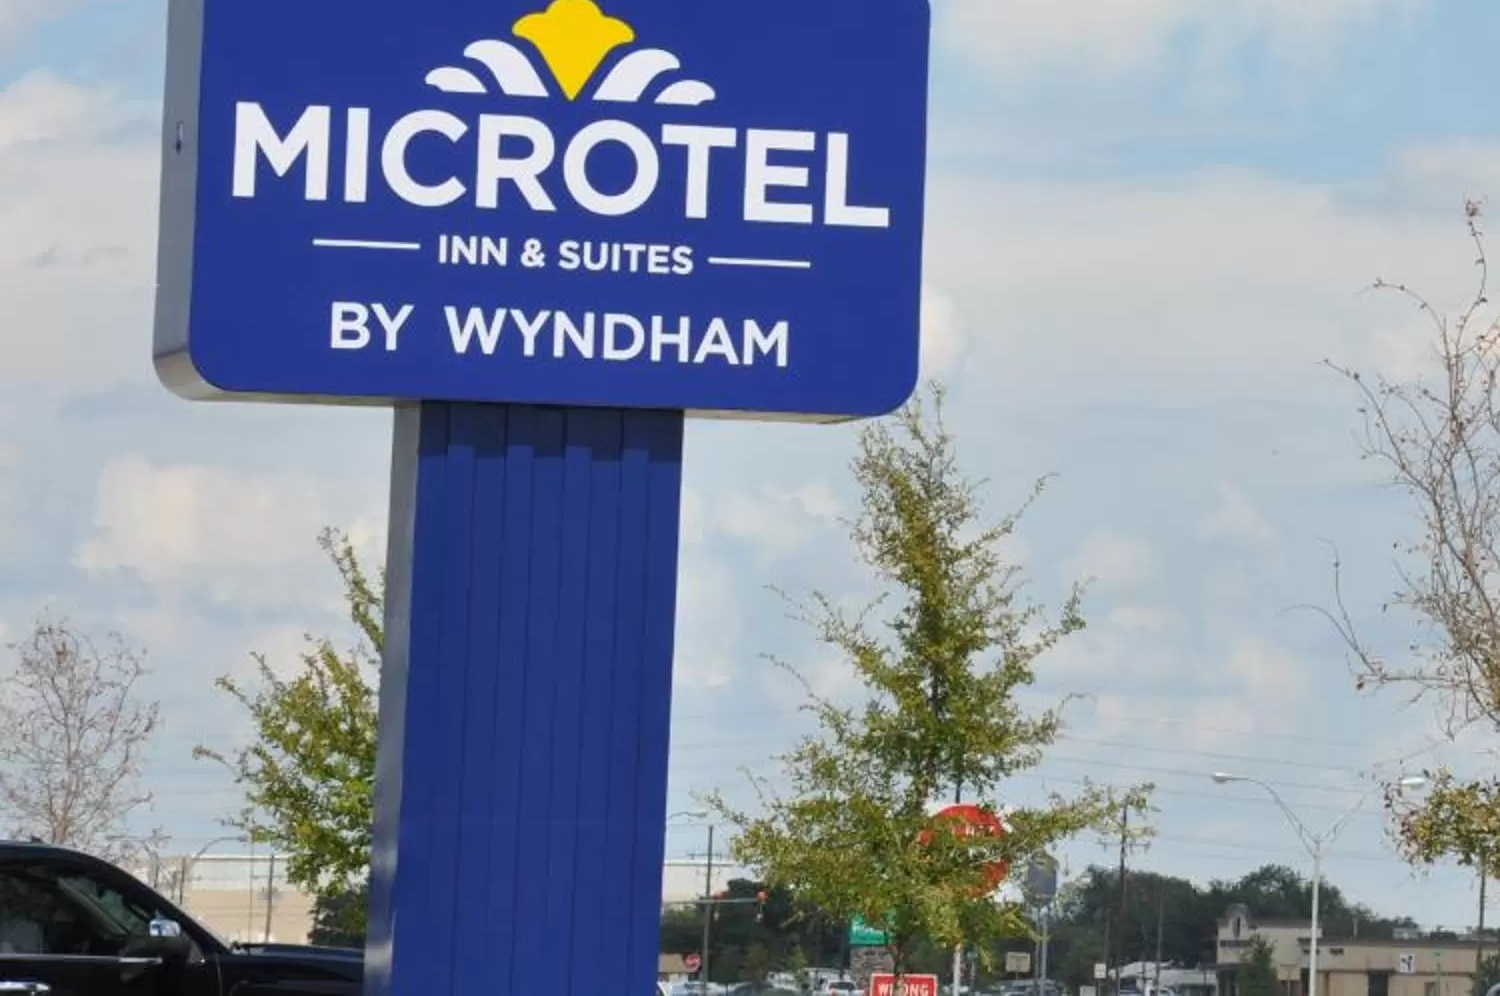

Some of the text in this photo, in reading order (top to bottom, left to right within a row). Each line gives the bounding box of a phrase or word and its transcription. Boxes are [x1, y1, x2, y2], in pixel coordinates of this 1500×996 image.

[231, 101, 891, 228] MICROTEL
[438, 234, 695, 275] INN & SUITES
[329, 301, 790, 368] BY WYNDHAM
